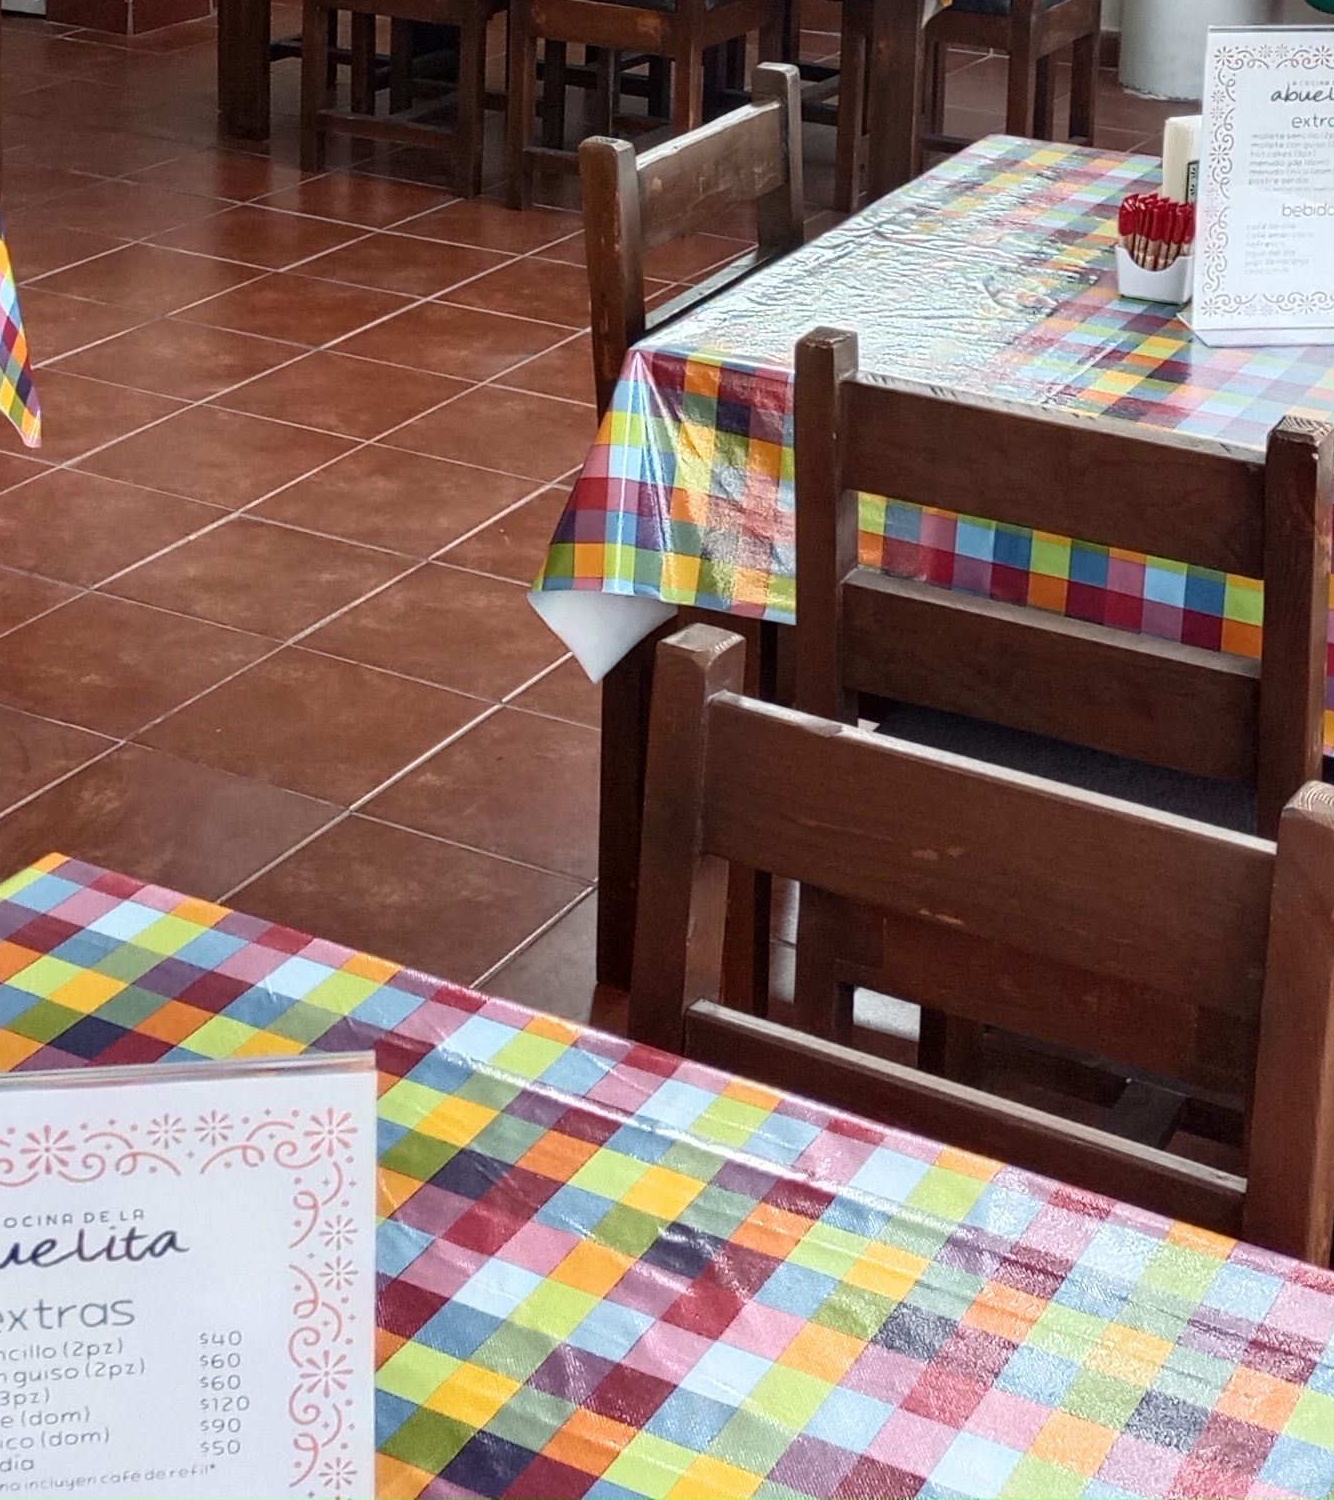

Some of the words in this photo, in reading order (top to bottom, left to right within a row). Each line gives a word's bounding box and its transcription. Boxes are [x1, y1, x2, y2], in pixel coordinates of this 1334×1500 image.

[83, 1211, 110, 1224] DE
[119, 1209, 145, 1222] LA
[63, 1337, 123, 1360] (2pz)
[199, 1330, 242, 1349] $40
[13, 1365, 79, 1389] guiso
[85, 1358, 145, 1380] (2pz)
[199, 1352, 241, 1371] $60
[199, 1374, 241, 1392] $60
[21, 1406, 90, 1427] (dom)
[200, 1395, 250, 1414] $120
[41, 1427, 110, 1448] (dom)
[200, 1418, 241, 1435] $90
[200, 1439, 241, 1457] $50
[24, 1476, 96, 1491] incluyen
[144, 1469, 166, 1481] de
